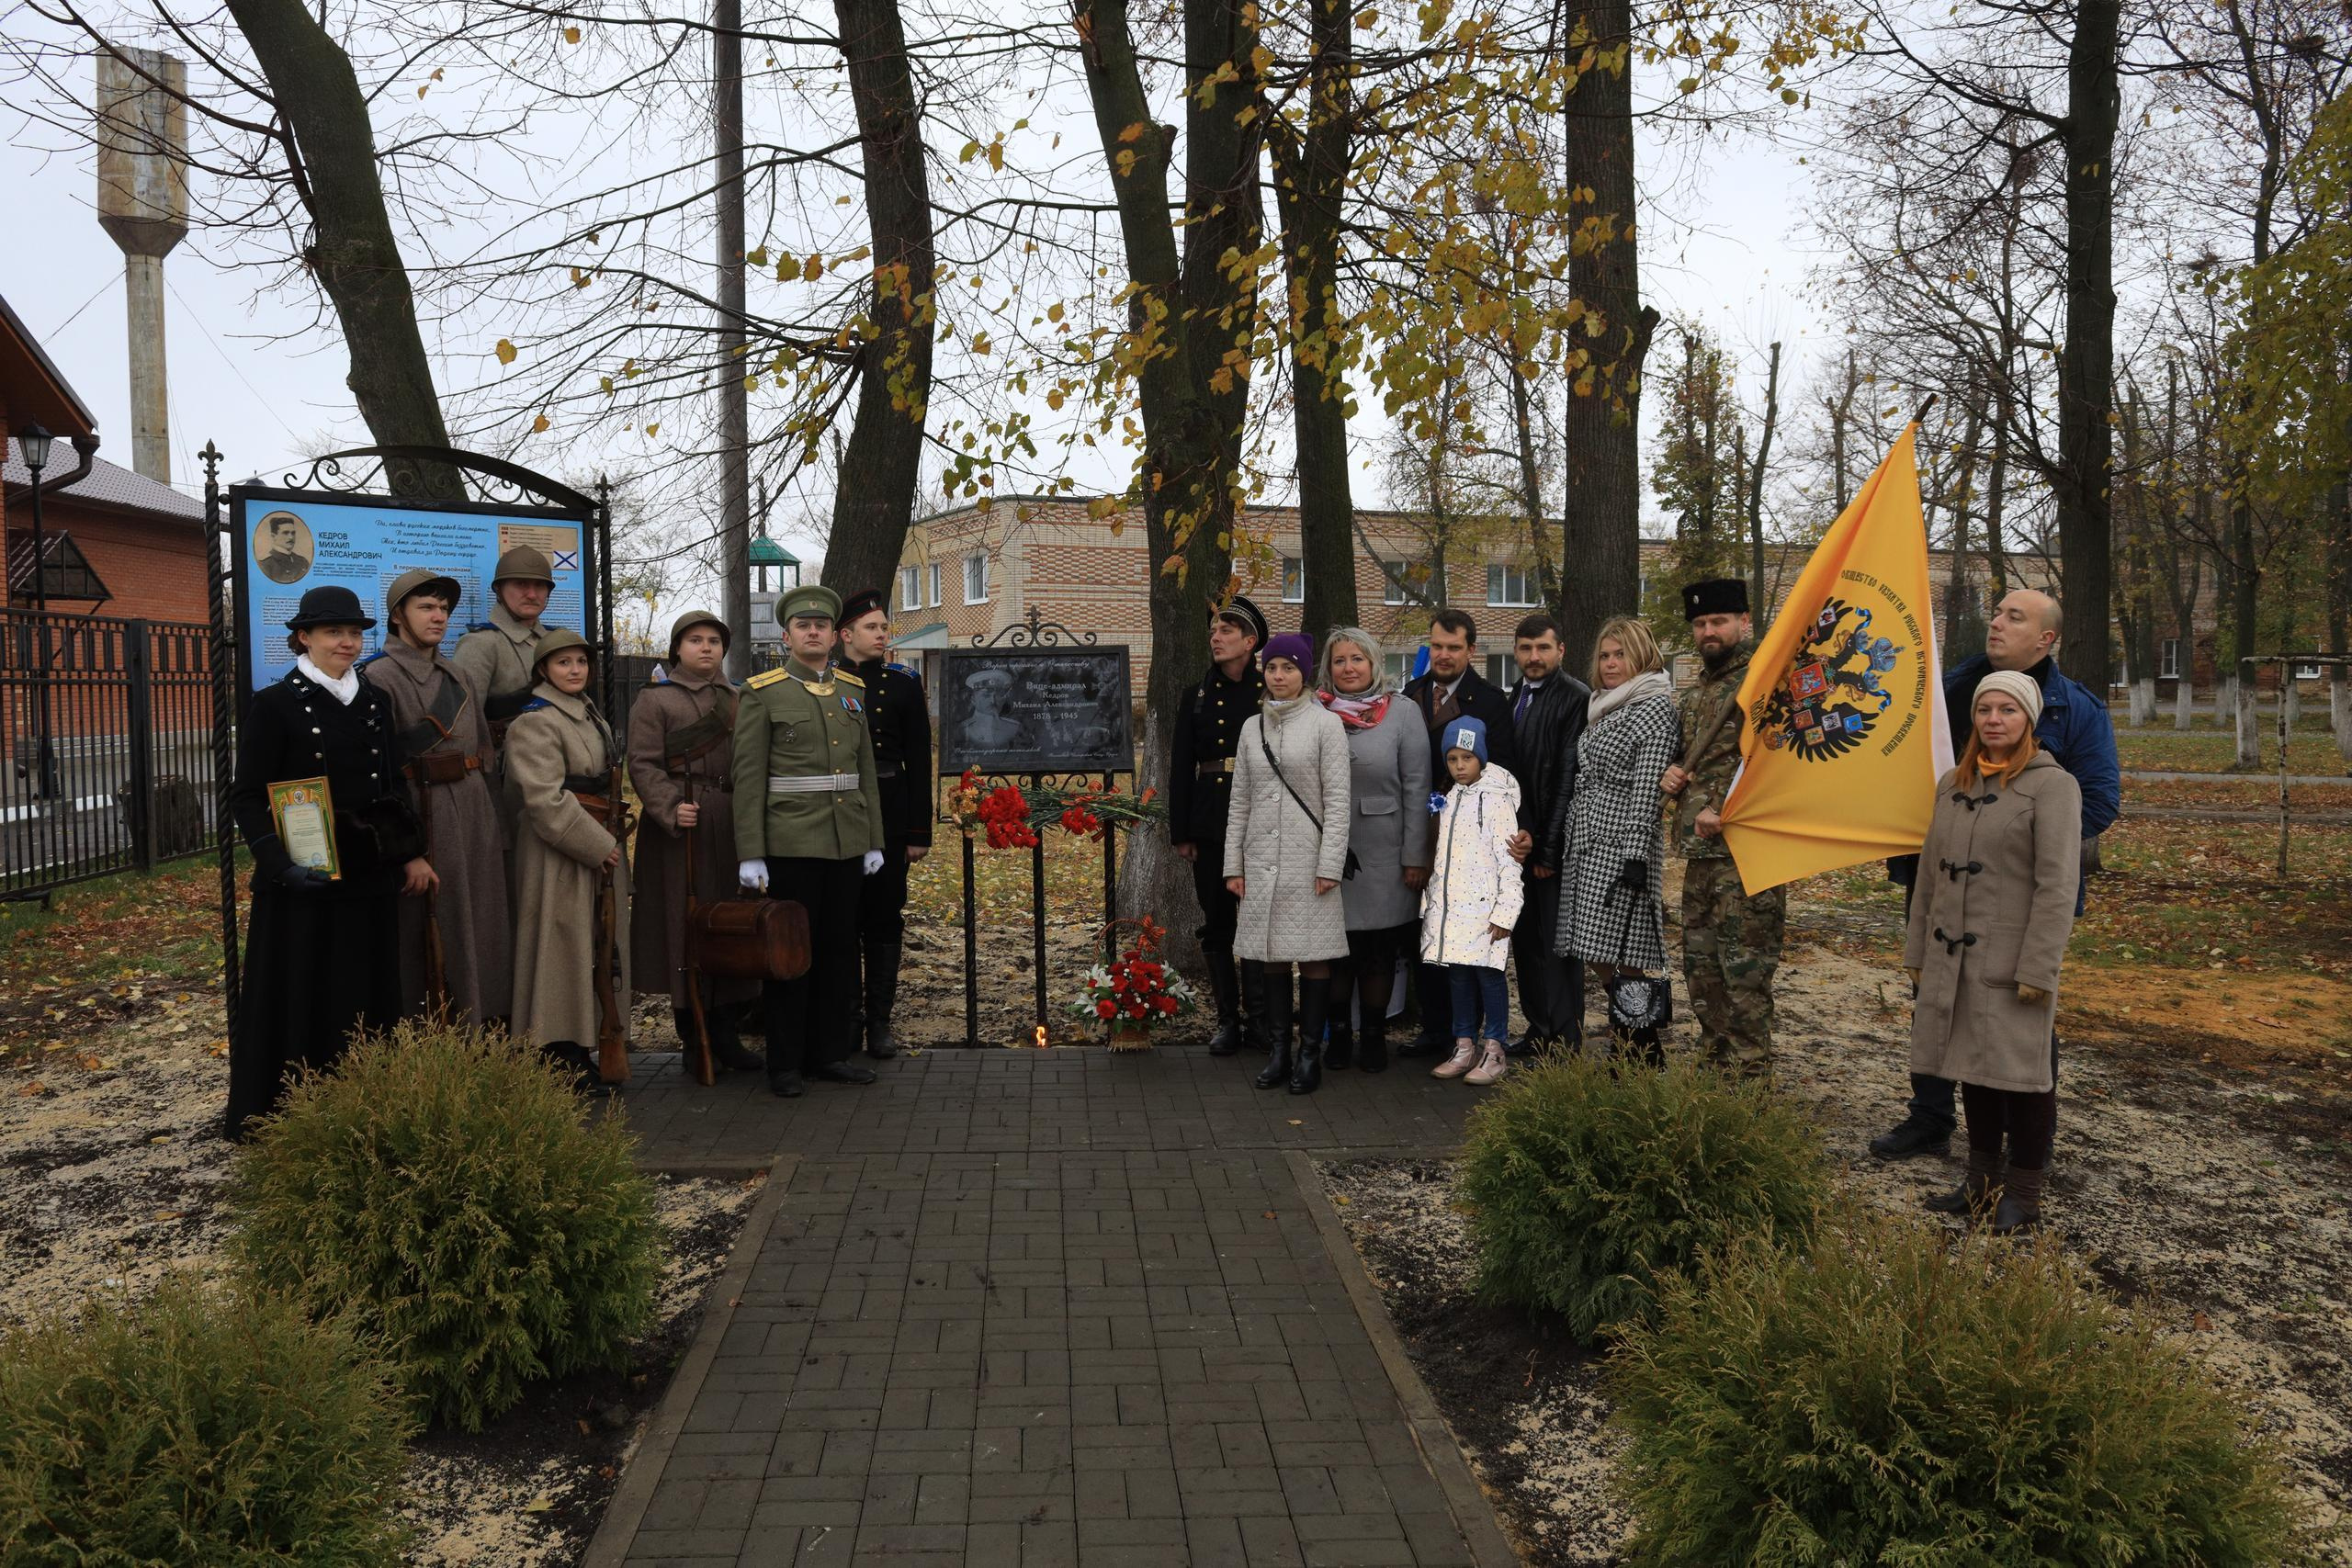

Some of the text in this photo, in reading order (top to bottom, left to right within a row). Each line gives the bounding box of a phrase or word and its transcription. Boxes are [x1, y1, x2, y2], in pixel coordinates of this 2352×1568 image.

[318, 531, 348, 540] КЕДРОВ
[318, 540, 350, 549] МИХАИЛ
[318, 550, 383, 560] АЛЕКСАНДРОВИЧ
[1841, 570, 1927, 757] ОБЩЕСТВО РАЗВИТИЯ РУССКОГО ИСТОРИЧЕСКОГО ПРОСВЕЩЕНИЯ
[1025, 682, 1086, 691] Вице-адмирал
[1042, 691, 1069, 700] Кедров
[1044, 700, 1099, 709] Александрович
[1060, 712, 1079, 720] 1945
